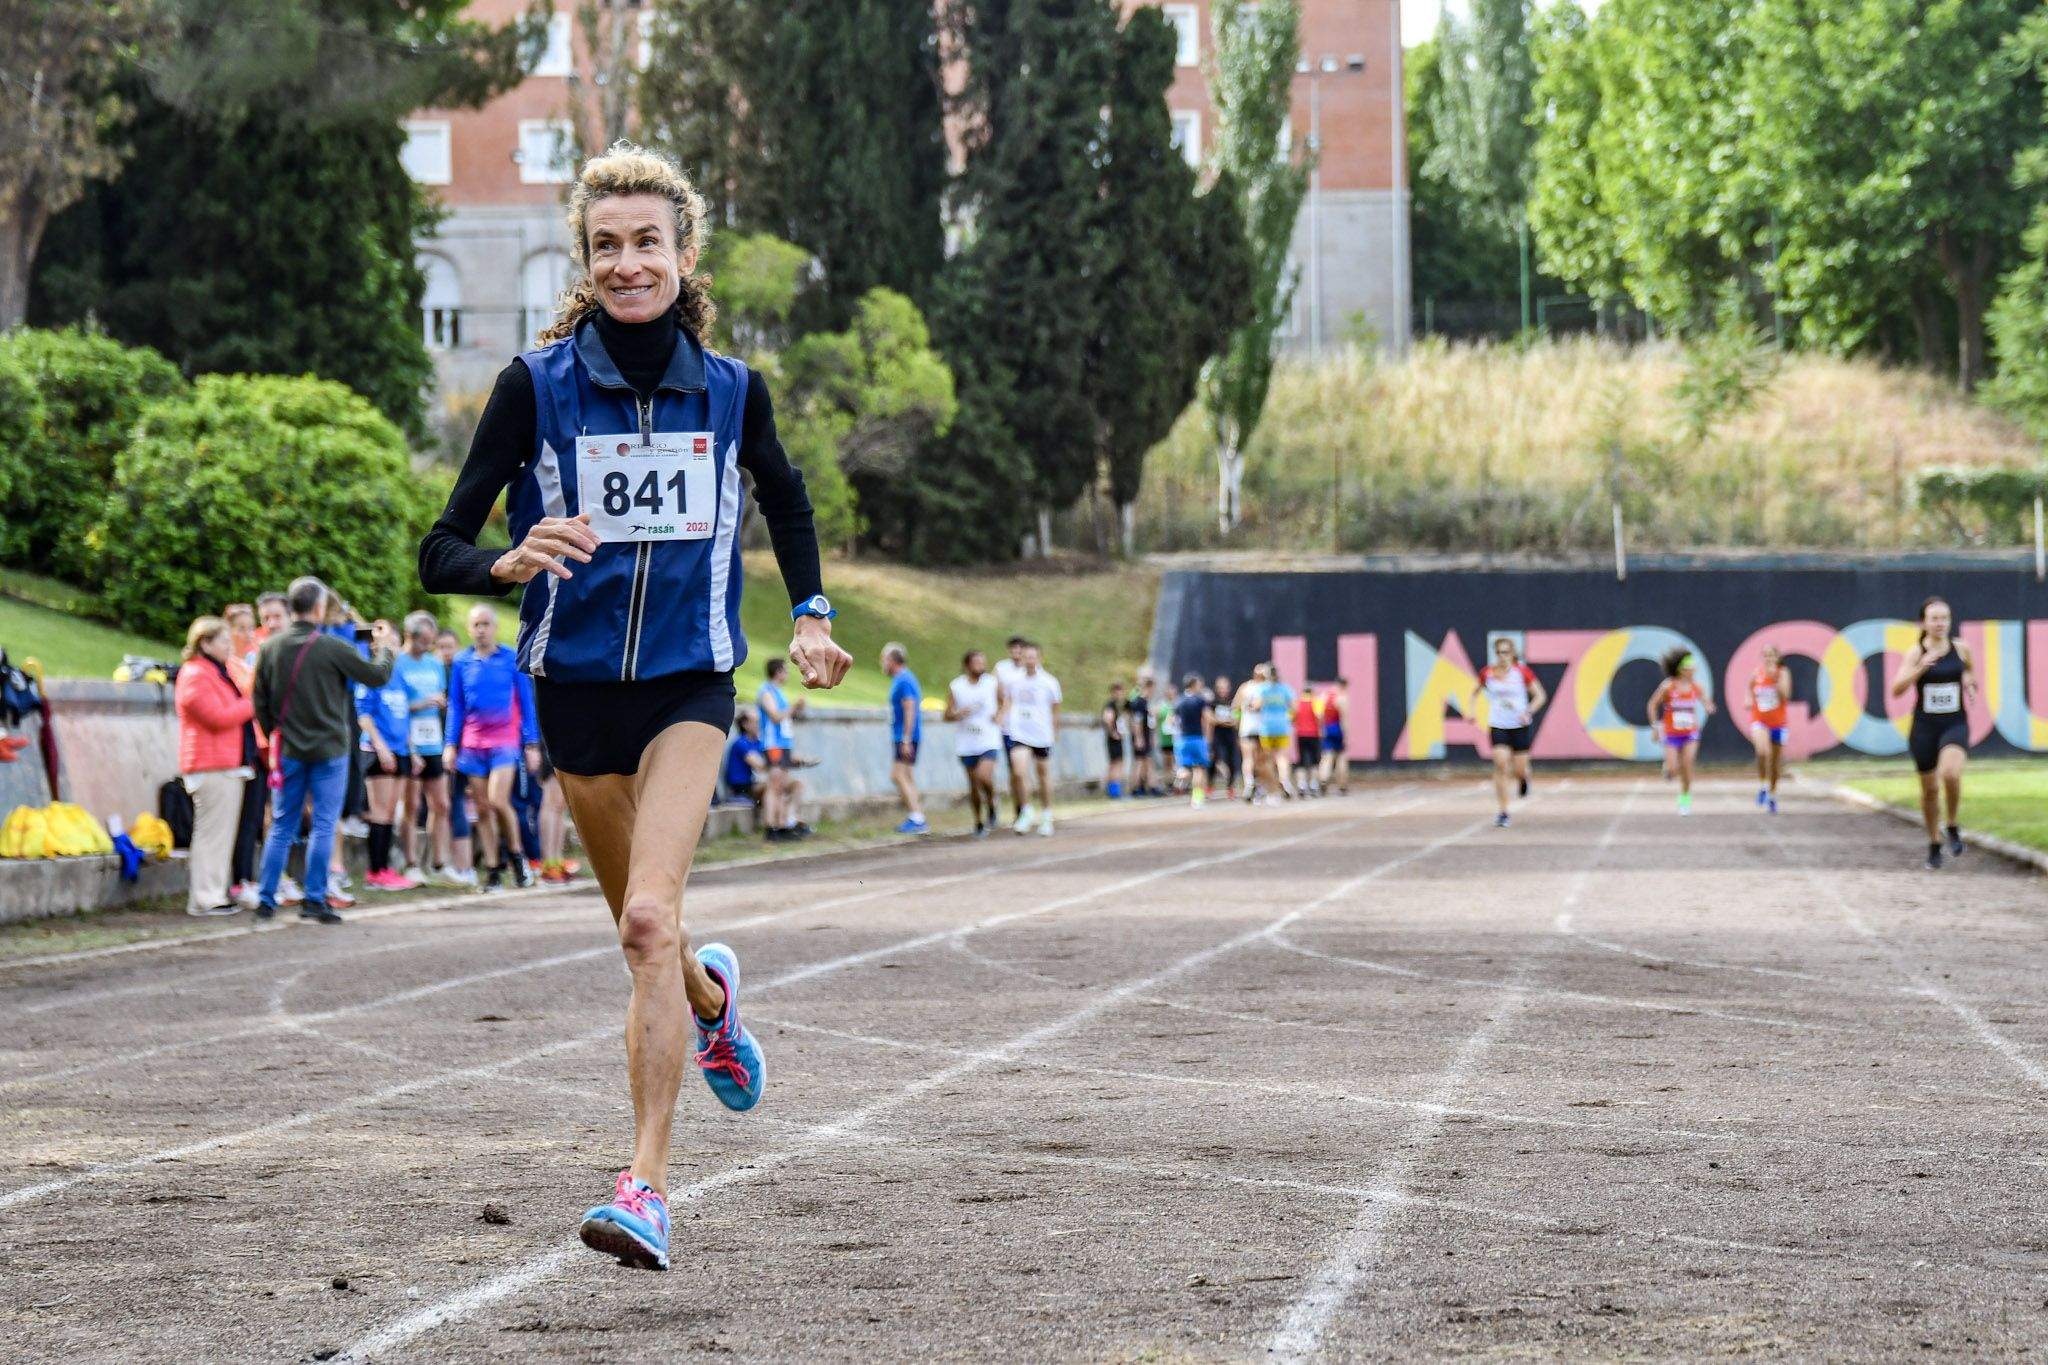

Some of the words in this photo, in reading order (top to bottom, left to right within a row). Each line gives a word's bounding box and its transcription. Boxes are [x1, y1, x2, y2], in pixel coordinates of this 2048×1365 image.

[603, 469, 688, 517] 841
[648, 523, 675, 534] rasán
[686, 522, 709, 532] 2023
